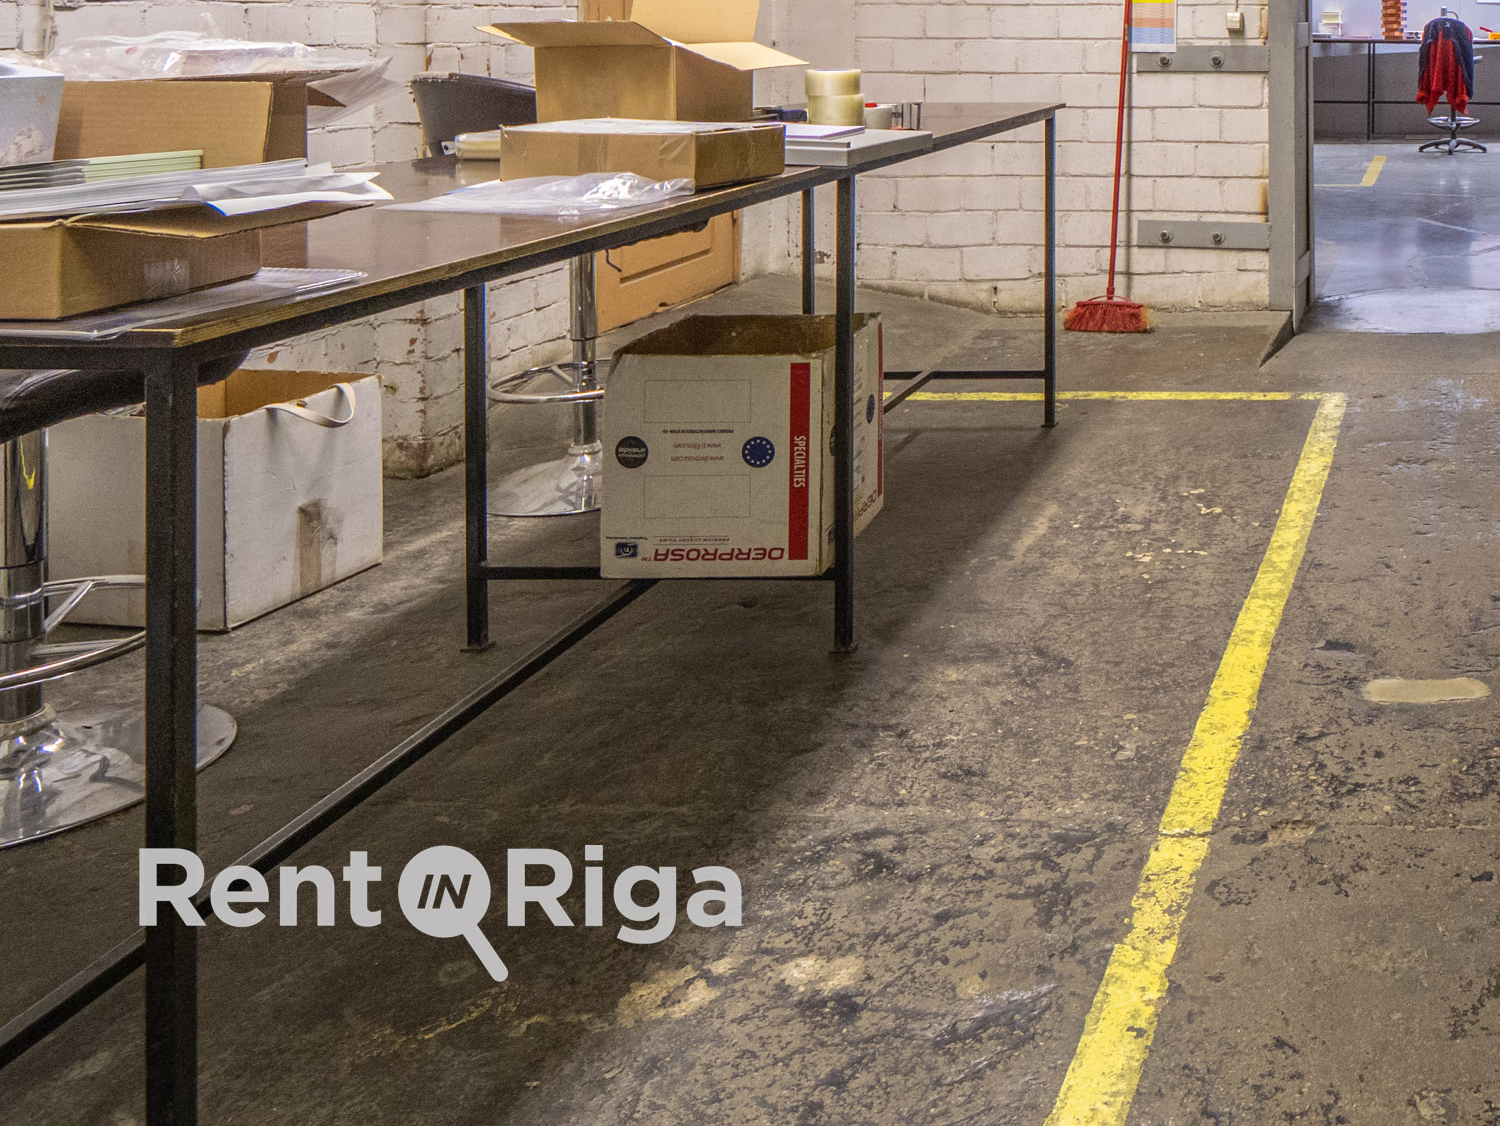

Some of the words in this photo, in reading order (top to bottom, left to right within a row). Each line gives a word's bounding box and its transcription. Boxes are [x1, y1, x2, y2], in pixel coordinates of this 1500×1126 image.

[671, 454, 724, 462] www.derprosa.com
[794, 436, 806, 488] SPECIALTIES
[654, 548, 785, 562] DERPROSA
